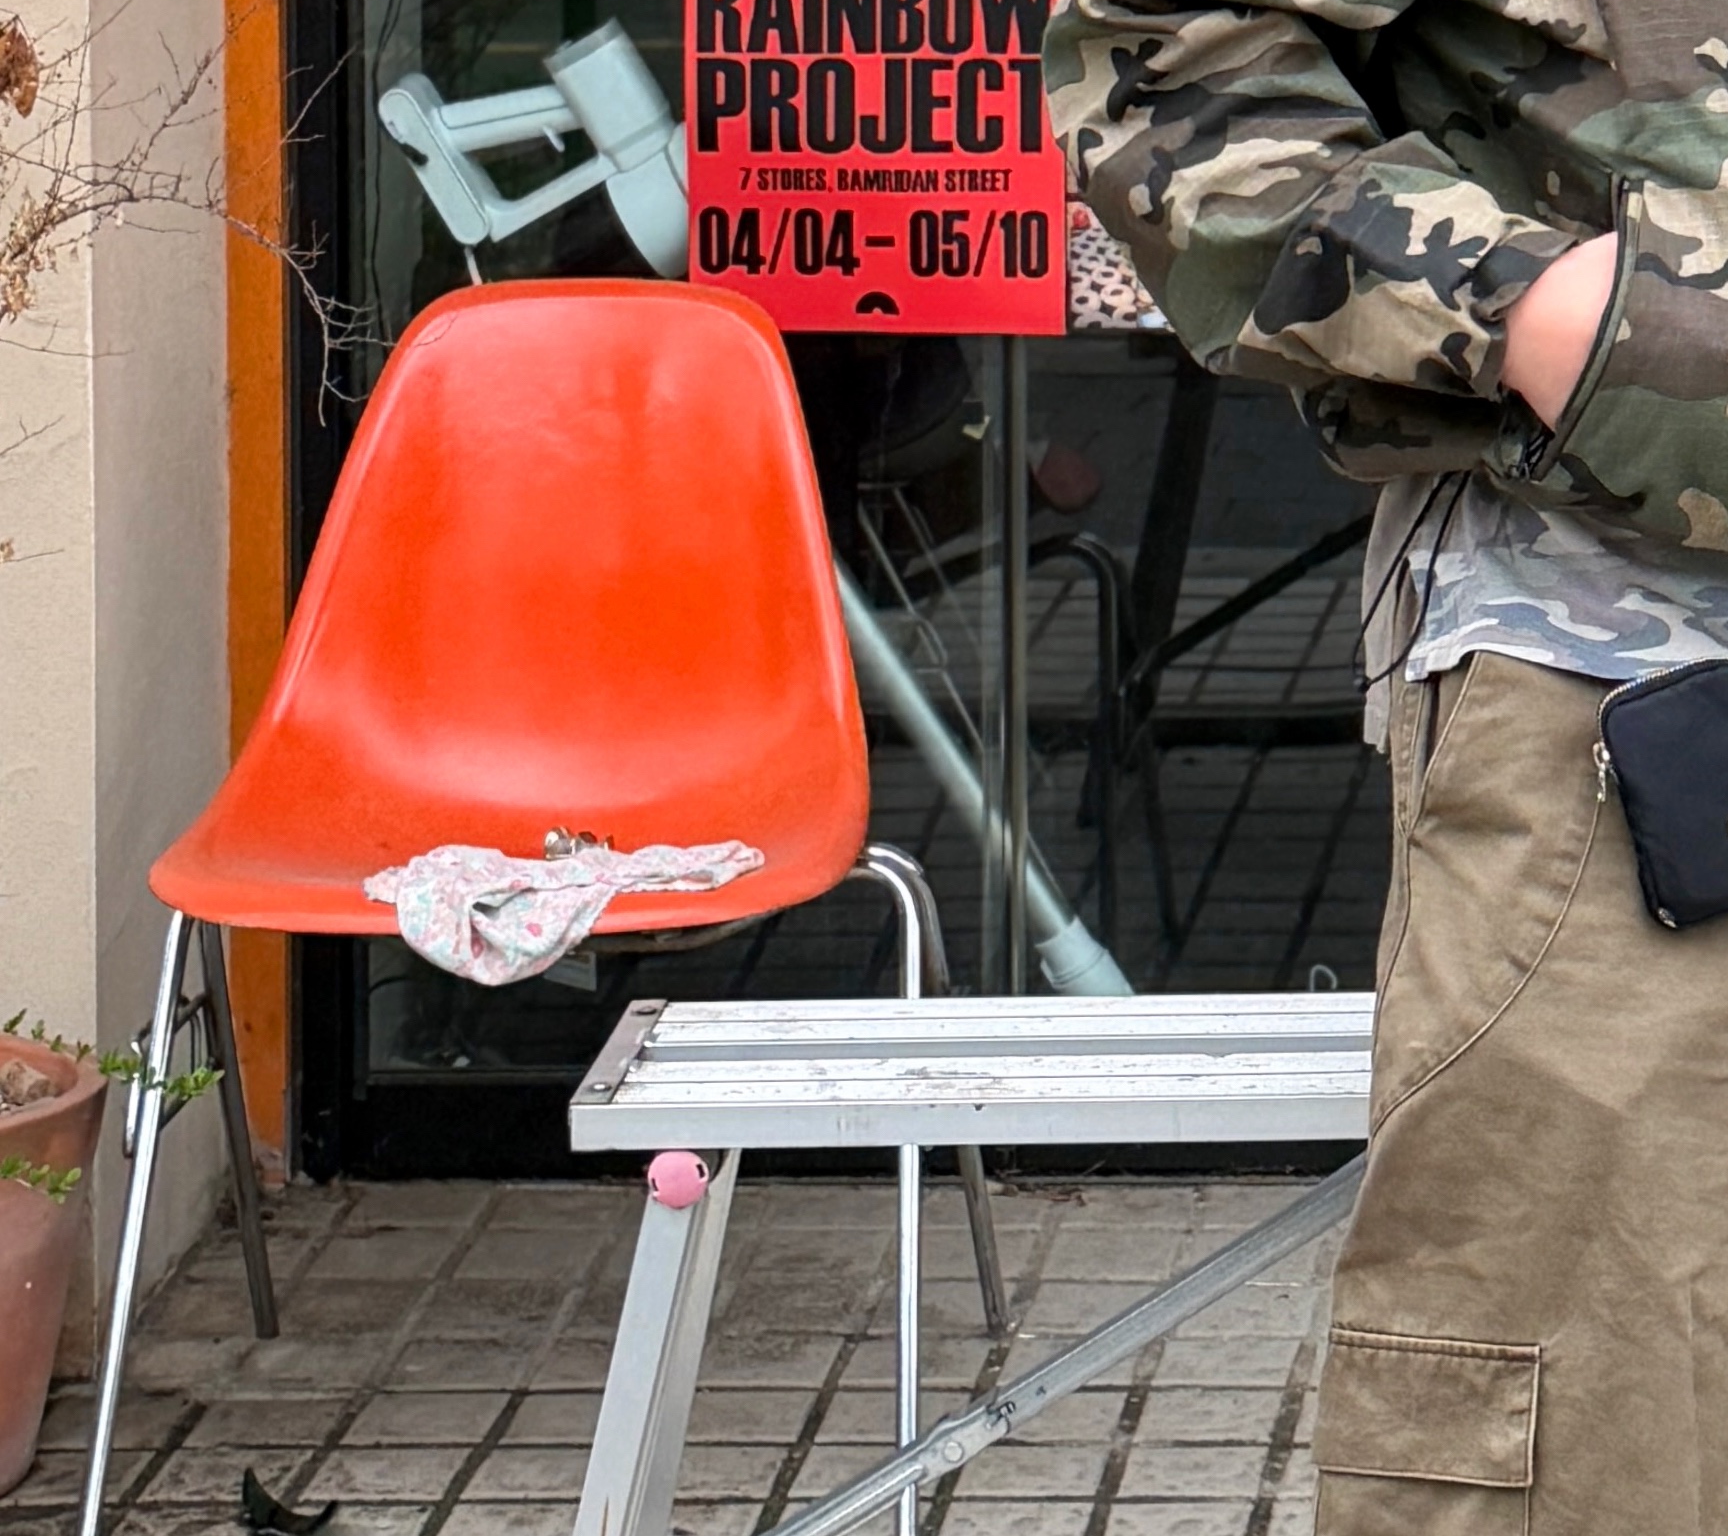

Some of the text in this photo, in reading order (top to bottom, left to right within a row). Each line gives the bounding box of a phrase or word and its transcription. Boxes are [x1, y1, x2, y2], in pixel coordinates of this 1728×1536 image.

[697, 57, 1044, 154] PROJECT
[740, 168, 751, 190] 7
[945, 168, 1012, 193] STREET
[909, 209, 1049, 277] 05/10
